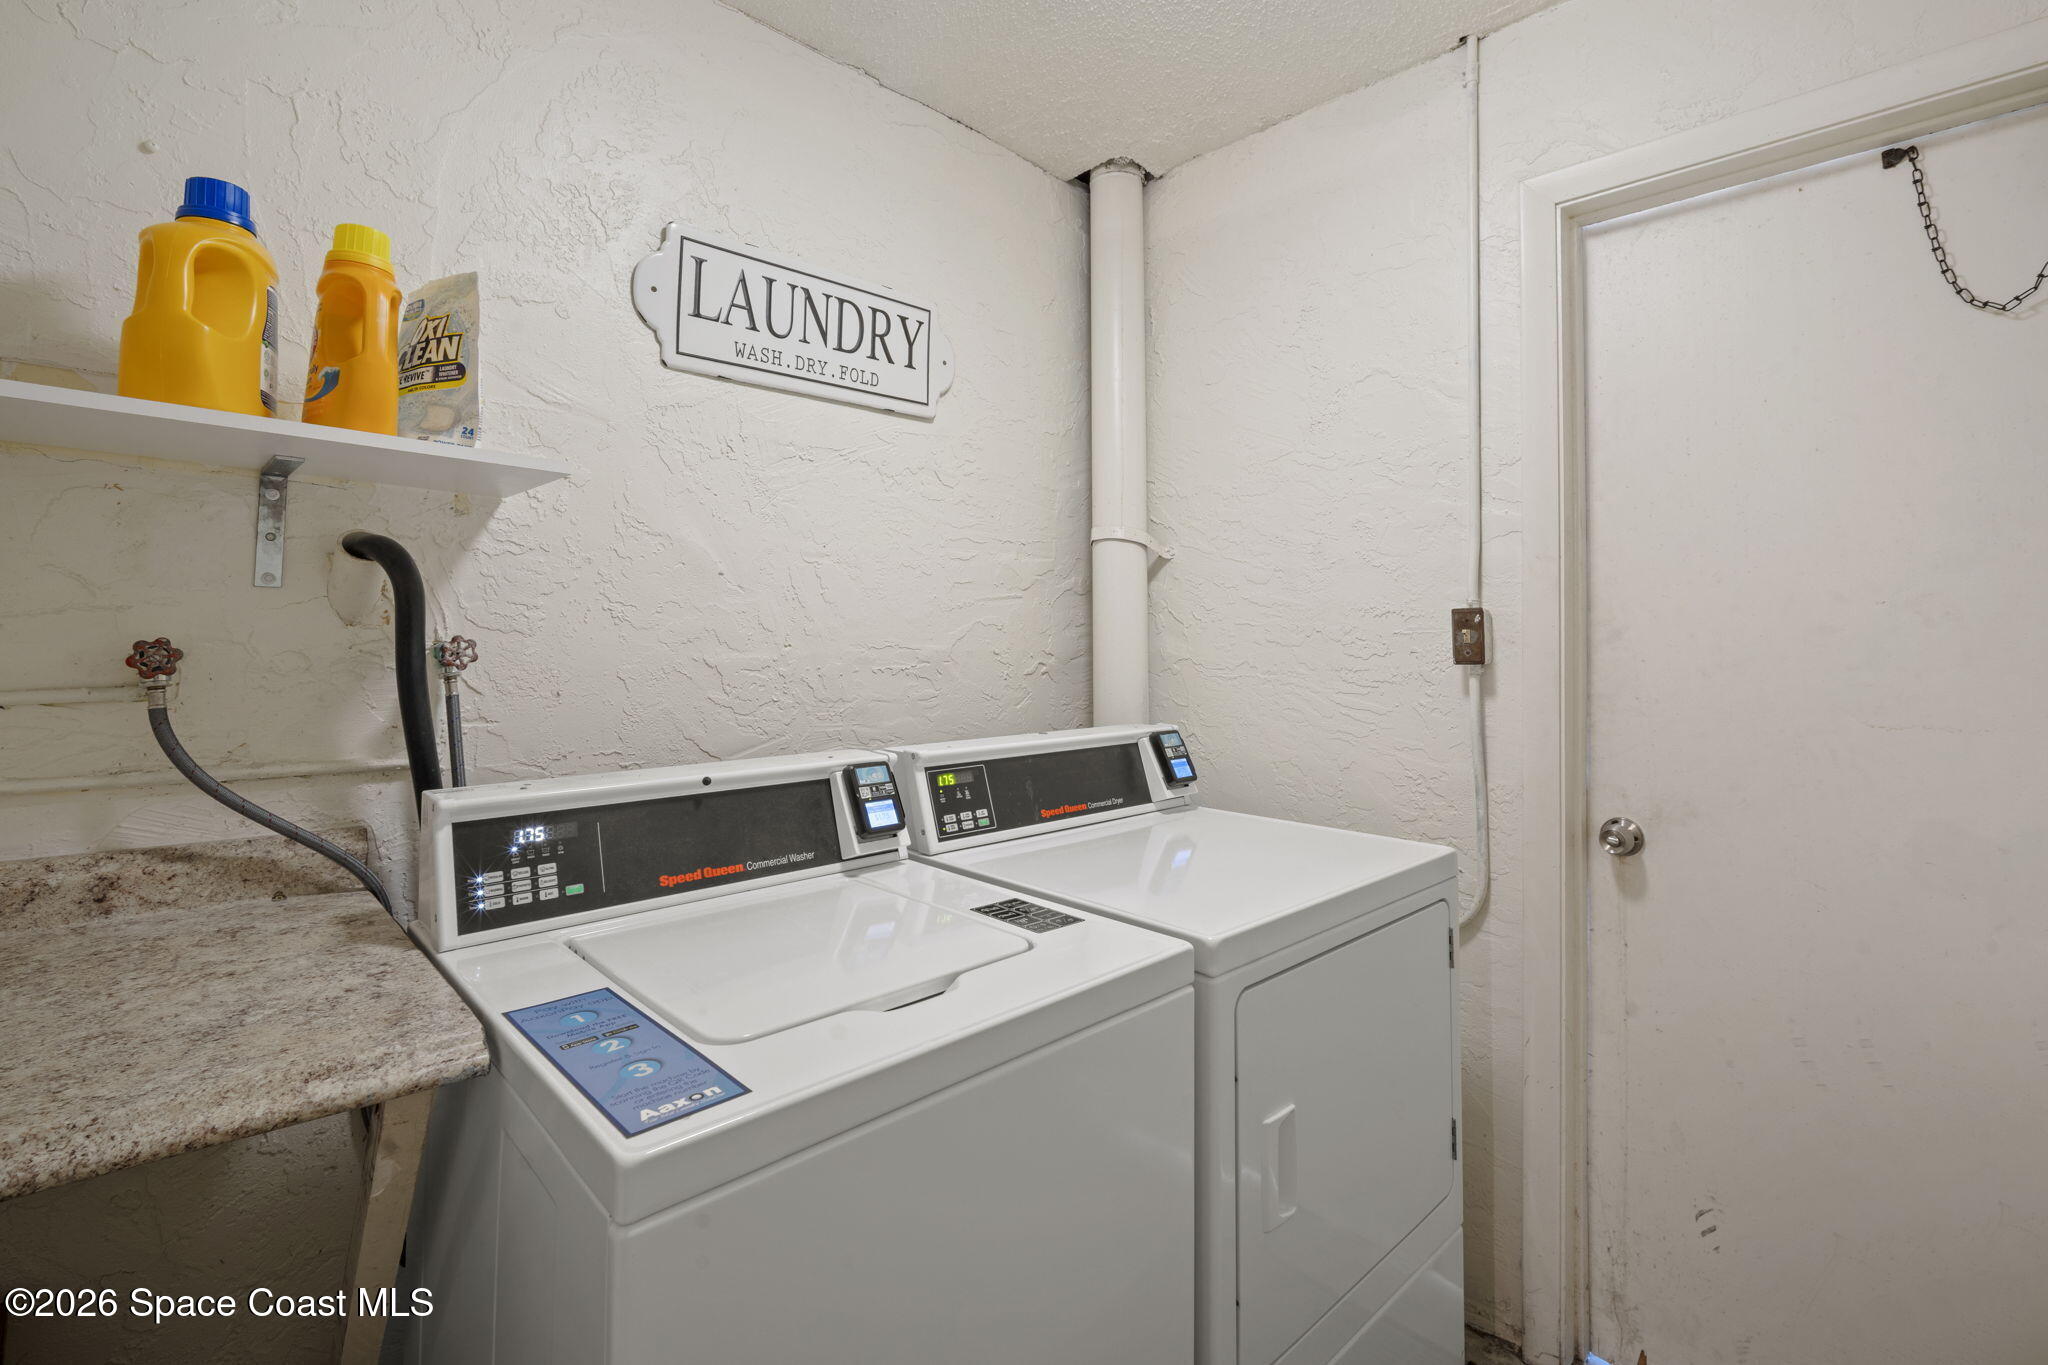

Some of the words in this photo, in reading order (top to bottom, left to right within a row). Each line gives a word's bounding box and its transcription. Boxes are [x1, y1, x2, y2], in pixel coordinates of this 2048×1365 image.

[688, 255, 924, 370] LAUNDRY
[461, 426, 474, 437] 24
[1040, 806, 1064, 818] Speed
[1064, 803, 1087, 814] Queen
[659, 869, 701, 887] Speed
[703, 863, 745, 879] Queen
[746, 855, 788, 871] Commercial
[788, 851, 815, 863] Washer
[570, 1015, 585, 1023] 1
[600, 1039, 625, 1052] 2
[627, 1063, 654, 1077] 3
[641, 1086, 722, 1122] Aaxon
